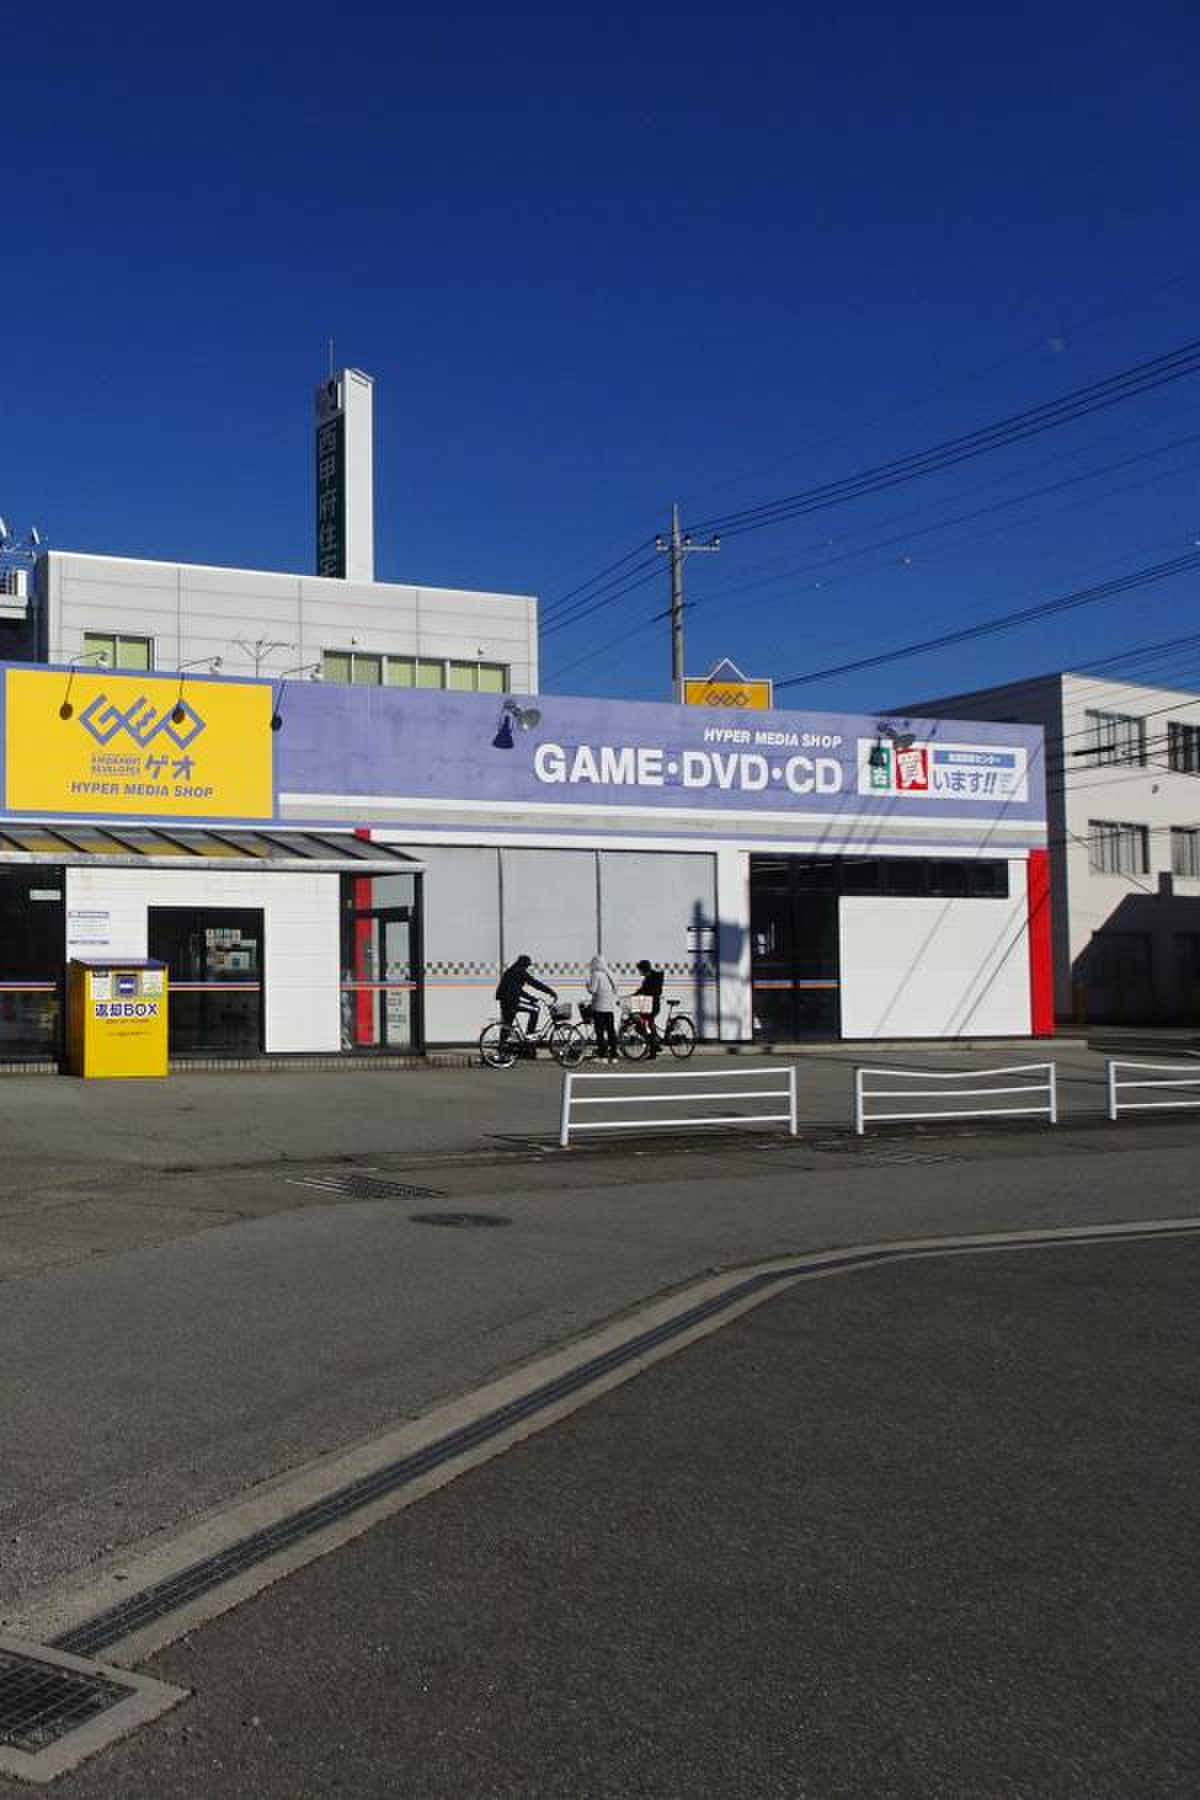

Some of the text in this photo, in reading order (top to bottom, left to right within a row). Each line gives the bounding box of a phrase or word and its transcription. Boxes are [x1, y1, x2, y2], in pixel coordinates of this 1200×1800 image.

[704, 728, 842, 749] HYPER MEDIA SHOP
[145, 753, 195, 781] ゲオ
[70, 782, 213, 799] HYPER MEDIA SHOP
